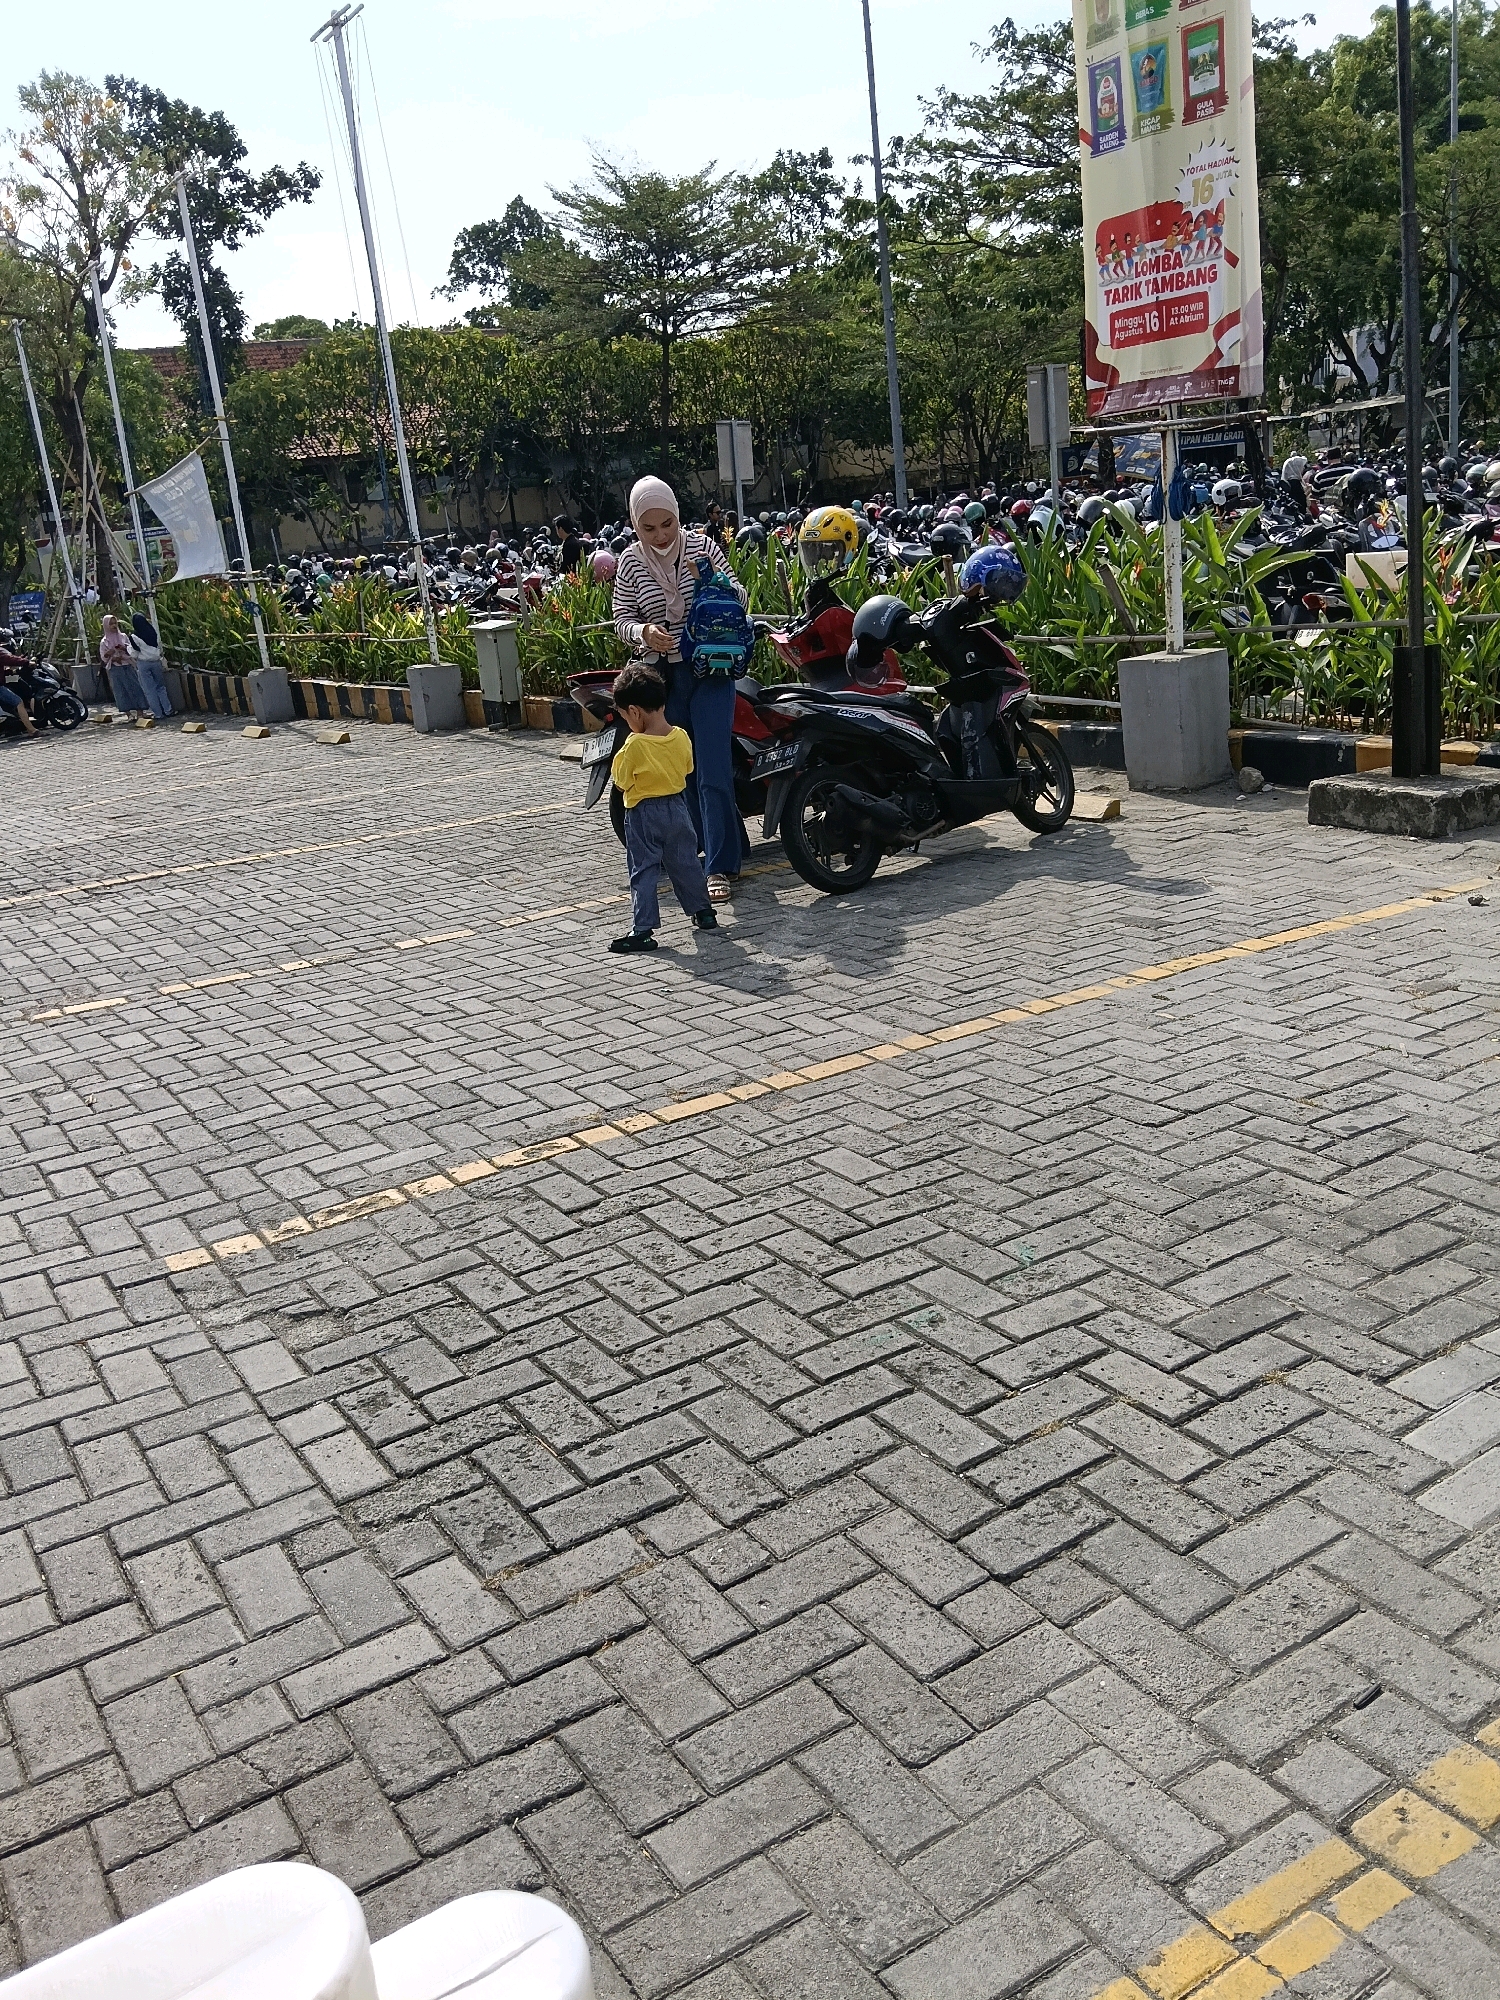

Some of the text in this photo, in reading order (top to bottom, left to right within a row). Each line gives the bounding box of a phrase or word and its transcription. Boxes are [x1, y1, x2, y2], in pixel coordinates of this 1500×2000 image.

[1135, 6, 1155, 20] BERAS
[1196, 99, 1214, 110] GULA
[1196, 107, 1215, 119] PASIR
[1140, 125, 1161, 135] MANIS
[1099, 131, 1119, 143] SARDEN
[1099, 139, 1120, 151] KALENG
[1186, 155, 1235, 176] TOTAL HADIAH
[1191, 173, 1215, 207] 16
[1215, 169, 1233, 181] JUTA
[1134, 251, 1183, 278] LOMBA
[1104, 264, 1218, 307] TARIK TAMBANG
[1171, 302, 1204, 315] 13.00 WIB
[1114, 310, 1160, 333] Minggu, 16
[1169, 313, 1204, 326] At Atrium
[1114, 328, 1144, 341] Agustus
[1202, 432, 1222, 443] HELM
[757, 755, 763, 767] B
